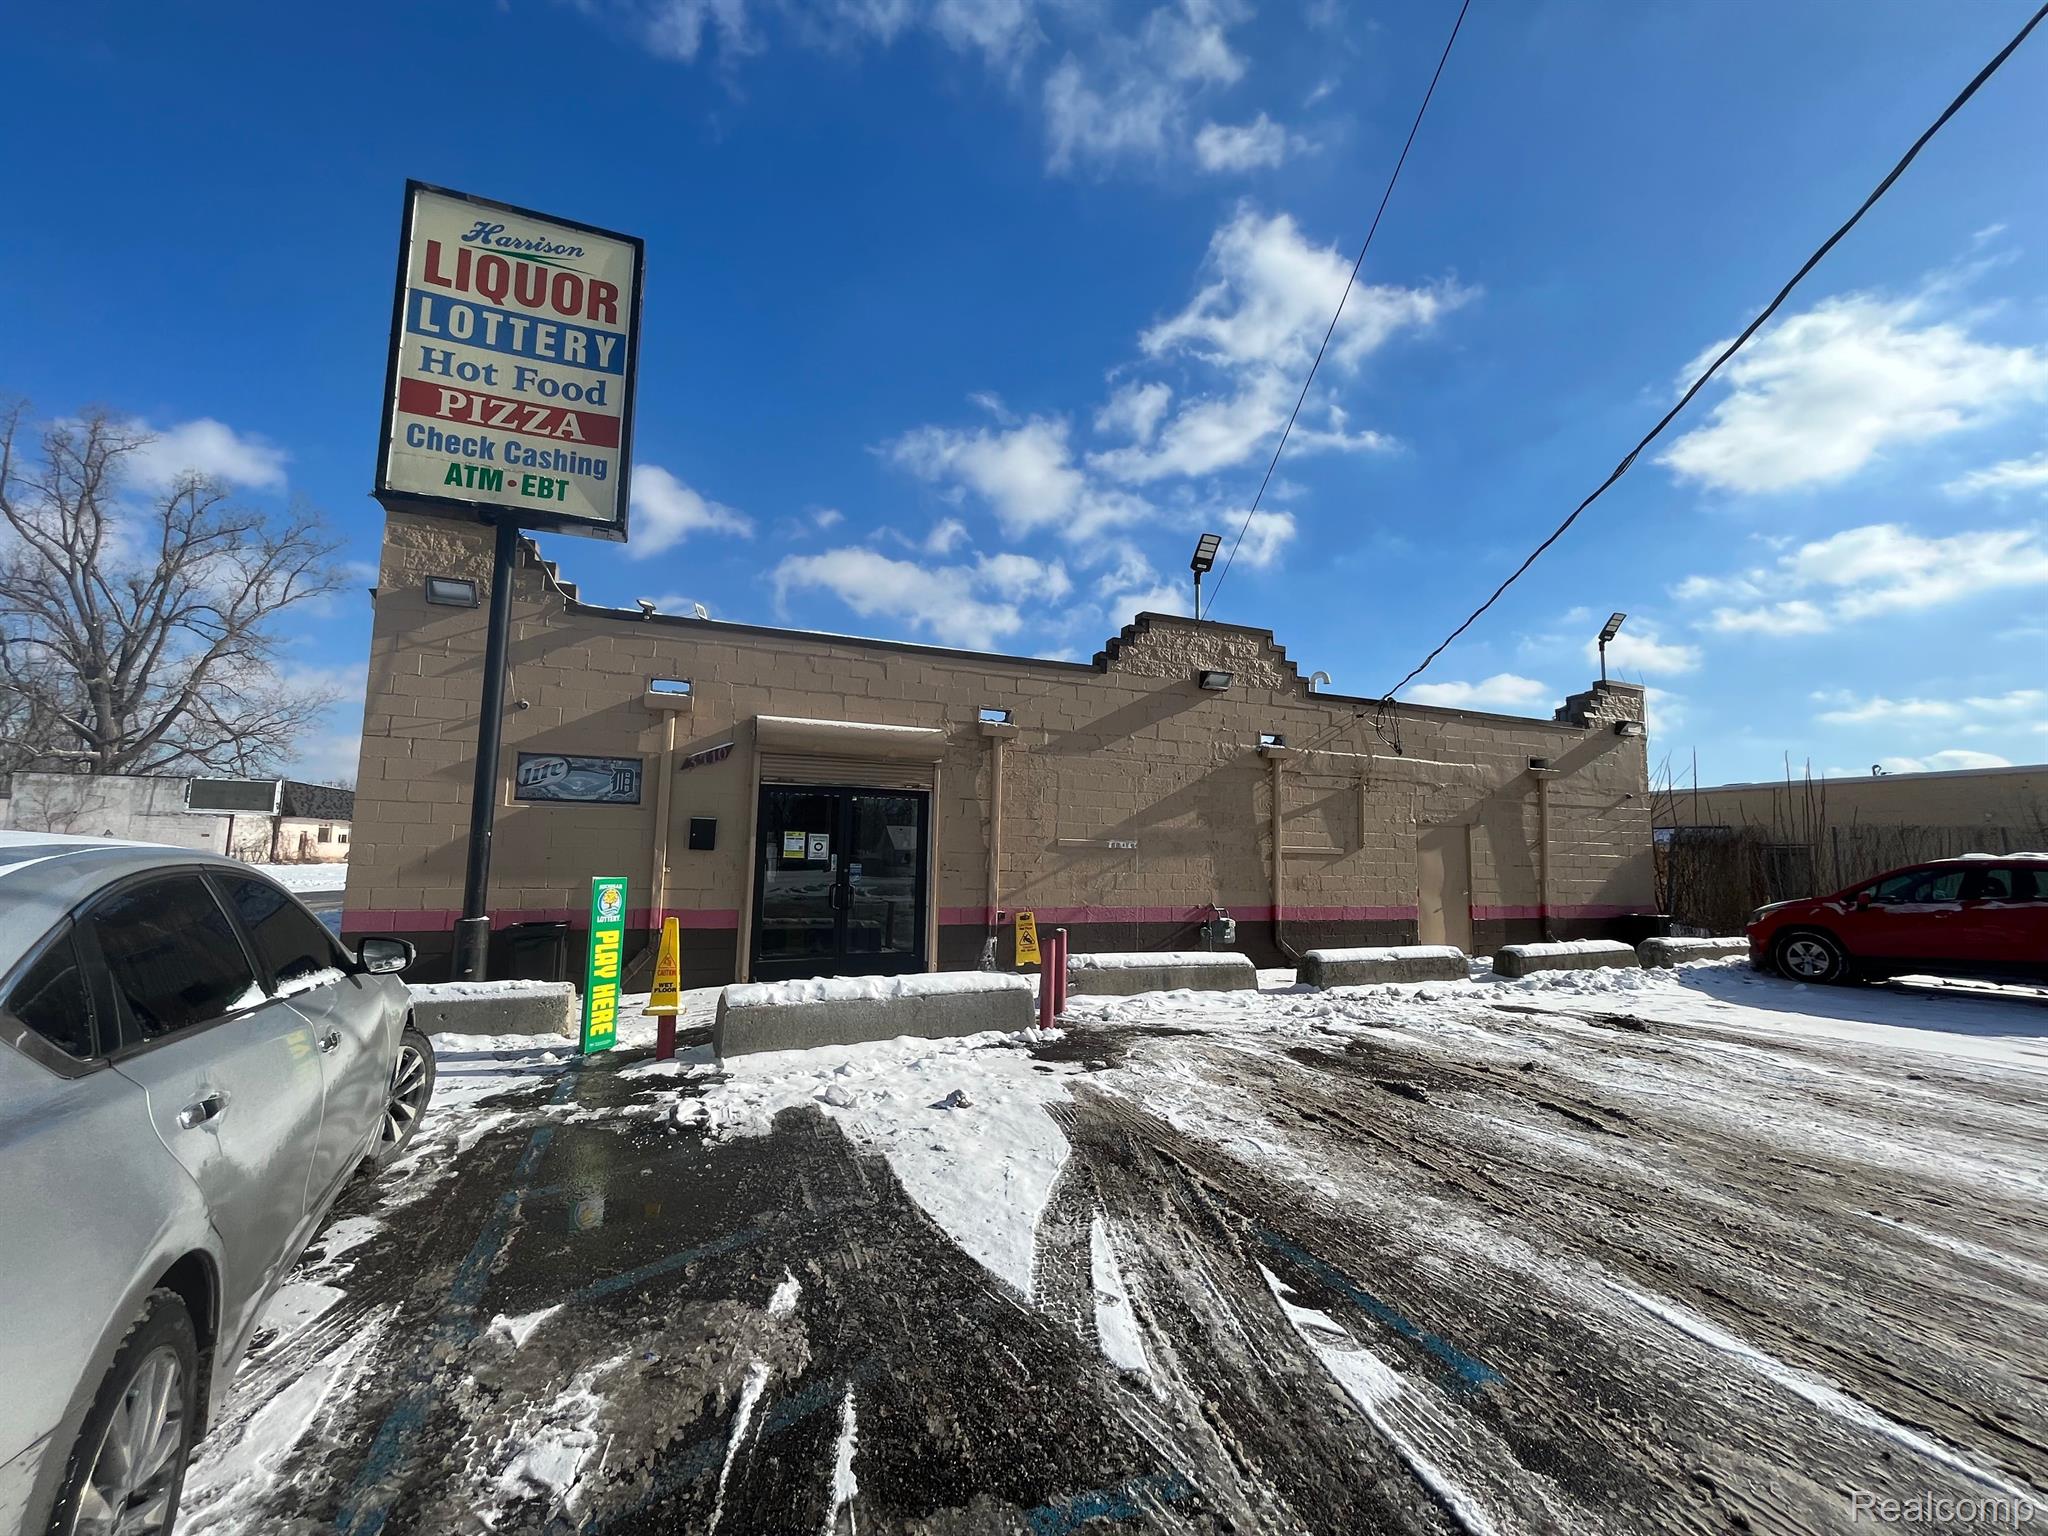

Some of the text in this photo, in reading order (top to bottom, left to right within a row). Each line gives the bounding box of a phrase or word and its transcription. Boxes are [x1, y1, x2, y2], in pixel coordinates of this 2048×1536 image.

[461, 221, 585, 258] Harrison
[424, 239, 619, 325] LIQUOR
[418, 297, 617, 368] LOTTERY
[418, 346, 608, 406] Hot Food
[436, 388, 586, 441] PIZZA
[406, 423, 608, 481] Check Cashing
[444, 462, 569, 501] ATM EBT
[596, 915, 621, 923] LOTTERY
[594, 930, 620, 979] PLAY
[590, 984, 616, 1037] HERE
